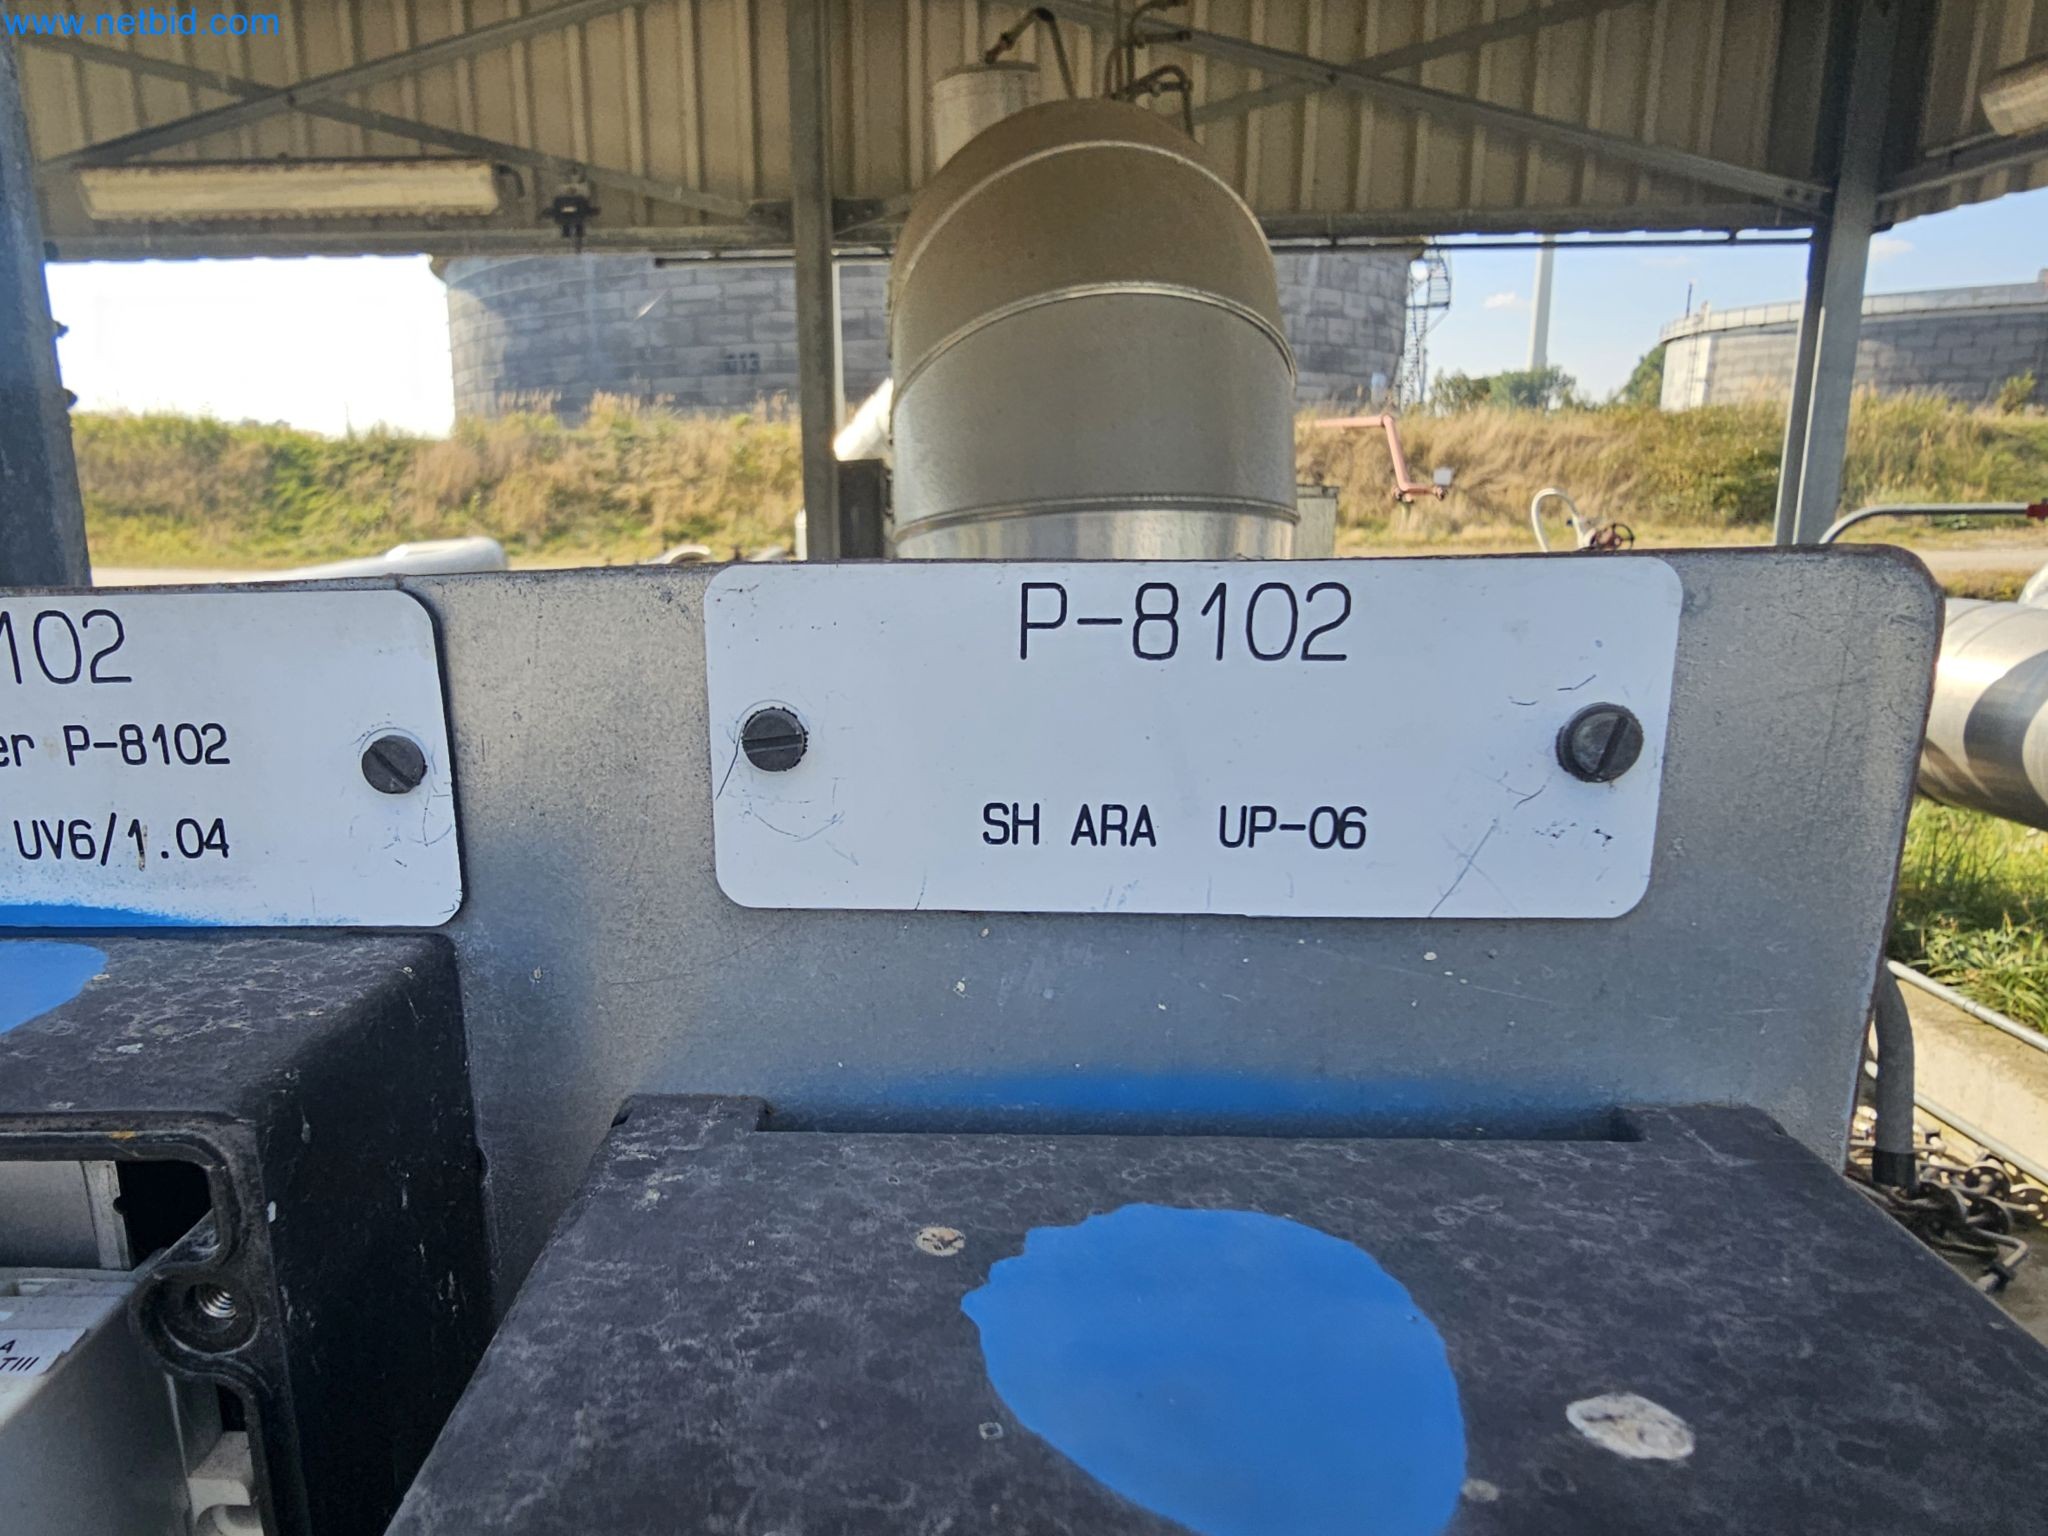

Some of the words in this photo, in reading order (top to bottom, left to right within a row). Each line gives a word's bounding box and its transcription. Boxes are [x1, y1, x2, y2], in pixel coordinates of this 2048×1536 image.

[0, 609, 132, 685] 102
[1020, 581, 1352, 661] P-8102
[62, 722, 231, 766] P-8102
[13, 812, 230, 871] UV6/1.04
[982, 802, 1040, 846] SH
[1070, 803, 1157, 847] ARA
[1219, 805, 1368, 850] UP-06
